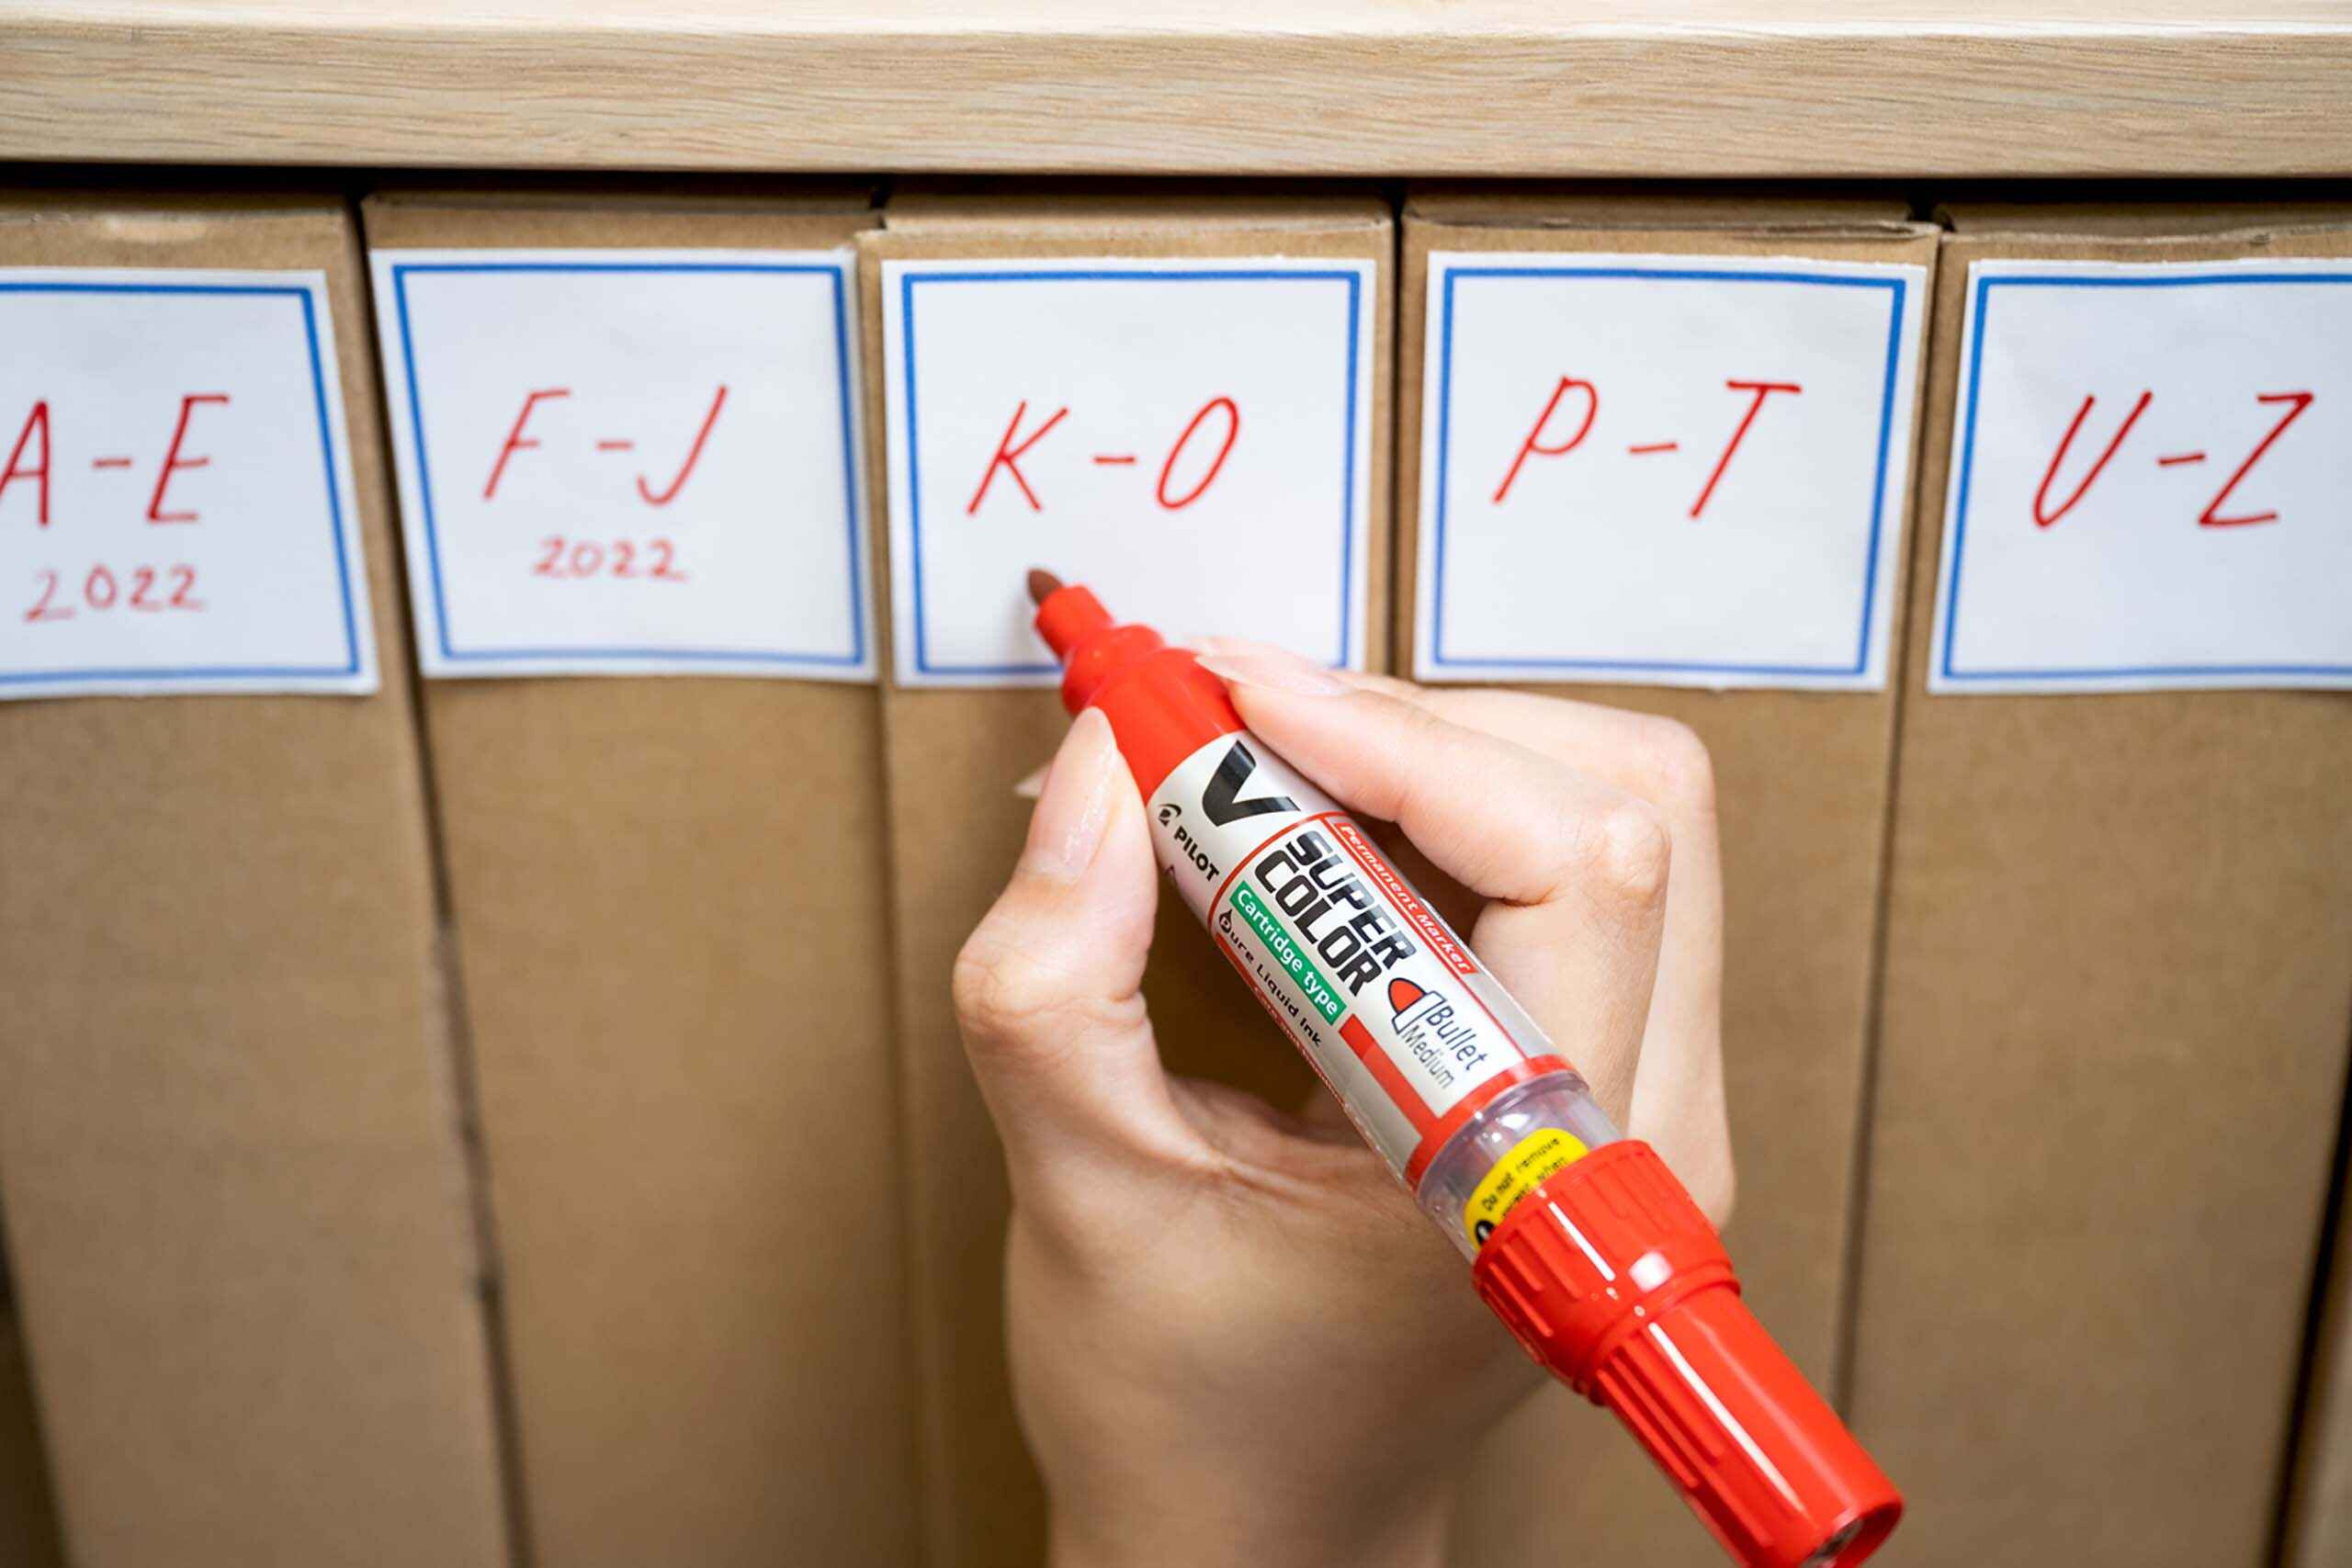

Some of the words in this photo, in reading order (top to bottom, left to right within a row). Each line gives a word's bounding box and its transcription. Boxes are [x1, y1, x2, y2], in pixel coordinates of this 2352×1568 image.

[25, 562, 207, 623] 2022
[531, 536, 688, 581] 2022
[1202, 739, 1301, 828] V
[1173, 825, 1220, 882] PILOT
[1253, 849, 1383, 998] COLOR
[1285, 829, 1417, 971] SUPER
[1340, 825, 1419, 911] Permanent
[1416, 913, 1471, 972] Marker
[1237, 888, 1304, 973] Cartridge
[1303, 970, 1338, 1015] type
[1256, 964, 1300, 1019] Liquid
[1299, 1018, 1321, 1048] Ink
[1425, 1004, 1488, 1071] Bullet
[1401, 1024, 1455, 1090] Medium
